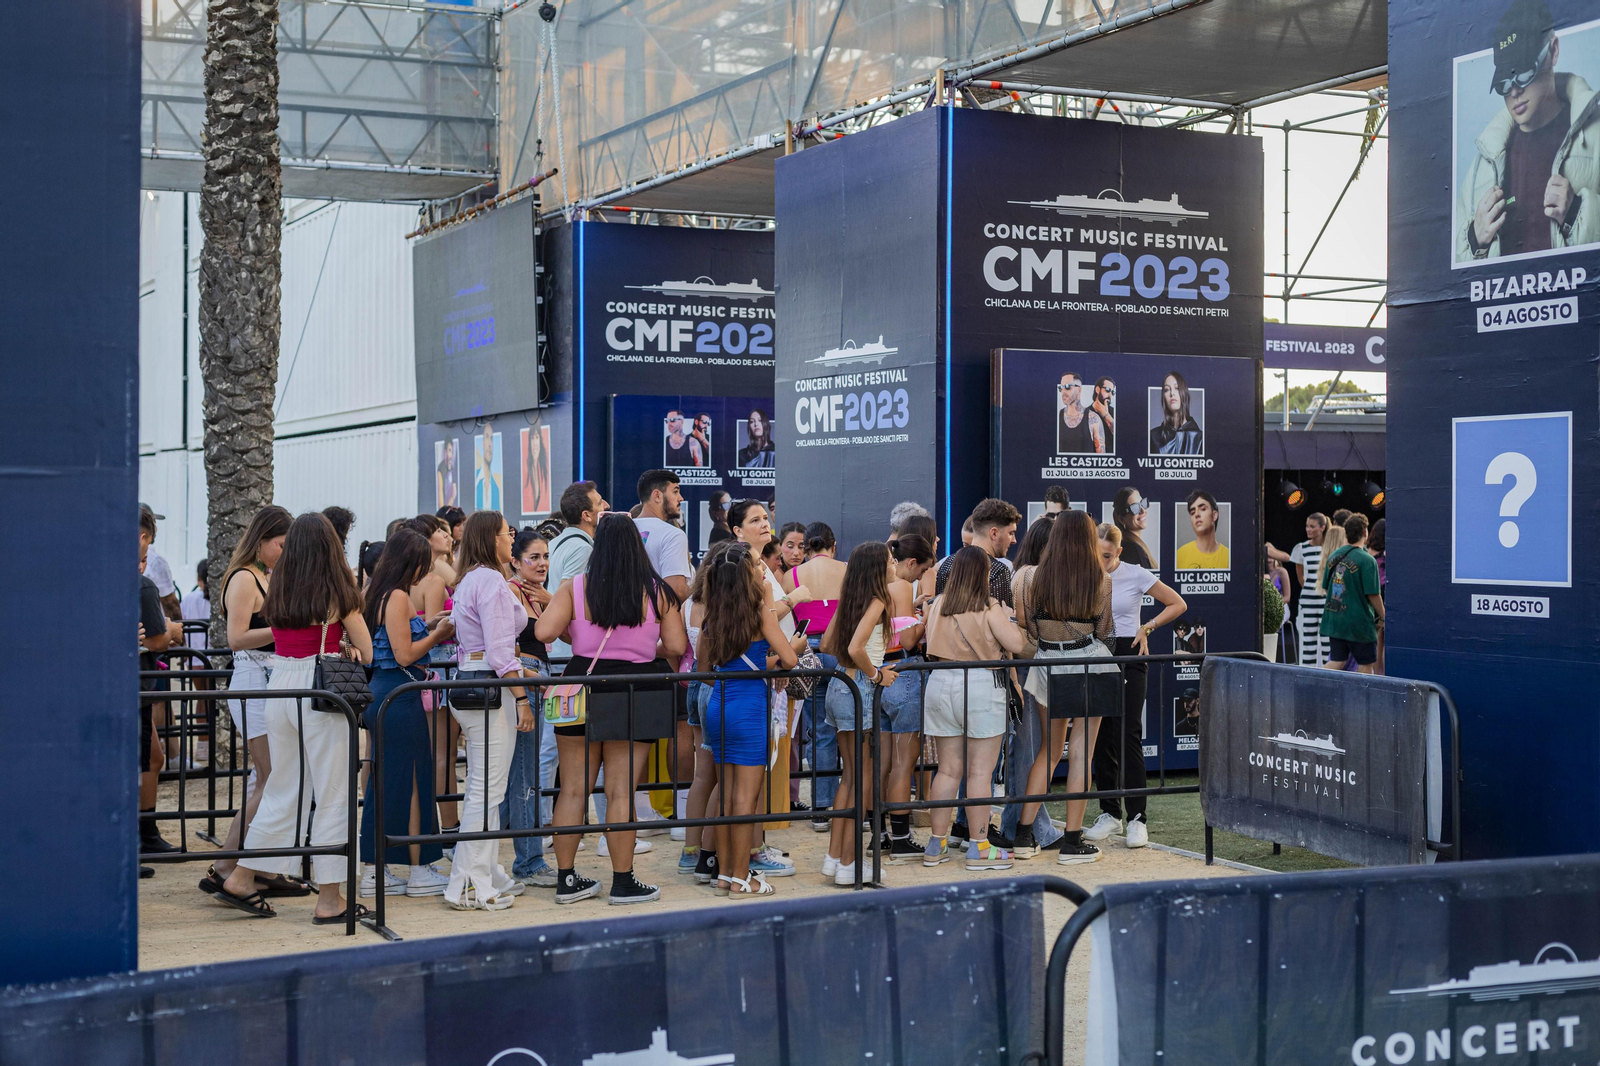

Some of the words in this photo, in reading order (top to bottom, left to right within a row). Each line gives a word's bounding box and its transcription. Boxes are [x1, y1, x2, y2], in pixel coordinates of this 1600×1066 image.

[984, 223, 1073, 242] CONCERT
[1080, 229, 1137, 246] MUSIC
[1144, 233, 1228, 252] FESTIVAL
[983, 245, 1230, 302] CMF2023
[1470, 267, 1586, 302] BIZARRAP
[606, 302, 676, 315] CONCERT
[680, 305, 725, 317] MUSIC
[984, 298, 1031, 308] CHICLANA
[1034, 300, 1046, 309] DE
[1048, 301, 1060, 309] LA
[1062, 302, 1109, 312] FRONTERA
[1116, 304, 1158, 314] POBLADO
[1160, 306, 1171, 314] DE
[1173, 307, 1203, 316] SANCTI
[1206, 308, 1229, 317] PETRI
[1483, 311, 1502, 327] 04
[1505, 303, 1572, 324] AGOSTO
[1266, 340, 1322, 353] FESTIVAL
[1325, 342, 1355, 354] 2023
[607, 354, 643, 362] CHICLANA
[708, 358, 741, 366] POBLADO
[795, 378, 832, 392] CONCERT
[835, 374, 862, 388] MUSIC
[864, 369, 908, 385] FESTIVAL
[795, 388, 909, 434] CMF2023
[1049, 457, 1068, 466] LES
[1070, 457, 1123, 467] CASTIZOS
[1137, 458, 1161, 467] VILU
[1164, 458, 1214, 468] GONTERO
[728, 470, 748, 478] VILU
[1175, 573, 1194, 582] LUC
[1197, 573, 1230, 582] LOREN
[1477, 599, 1490, 611] 18
[1492, 599, 1544, 614] AGOSTO
[1249, 752, 1308, 775] CONCERT
[1316, 764, 1356, 785] MUSIC
[1263, 774, 1339, 799] FESTIVAL
[1351, 1015, 1580, 1066] CONCERT
